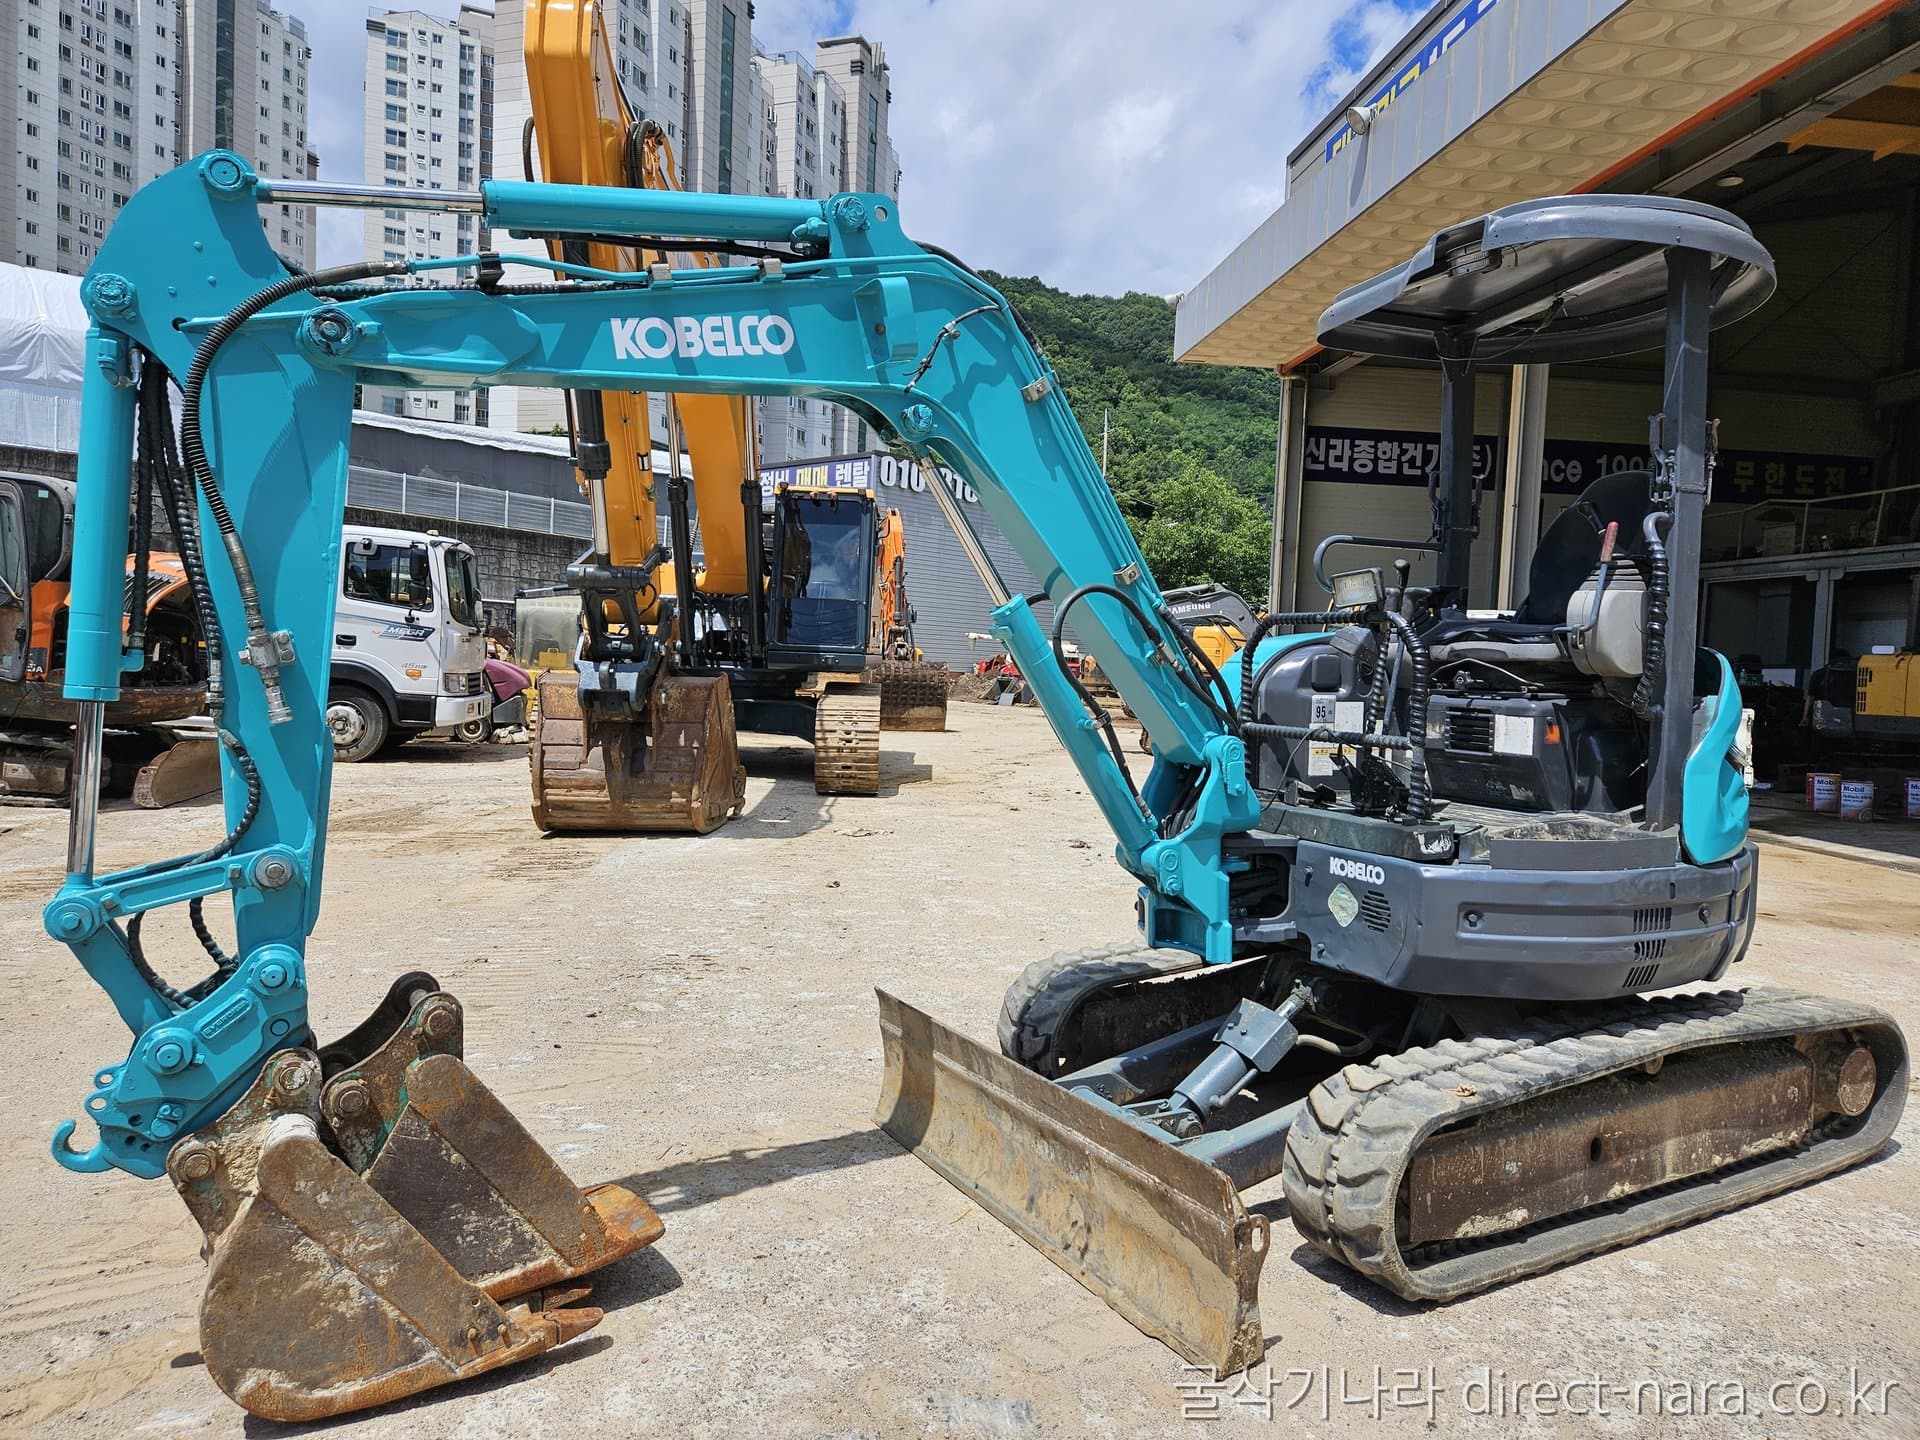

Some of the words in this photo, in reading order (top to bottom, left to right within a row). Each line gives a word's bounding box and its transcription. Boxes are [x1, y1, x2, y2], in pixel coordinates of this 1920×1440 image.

[610, 315, 795, 360] KOBELCO
[1316, 706, 1326, 718] 95
[1329, 856, 1385, 885] KOBELCO
